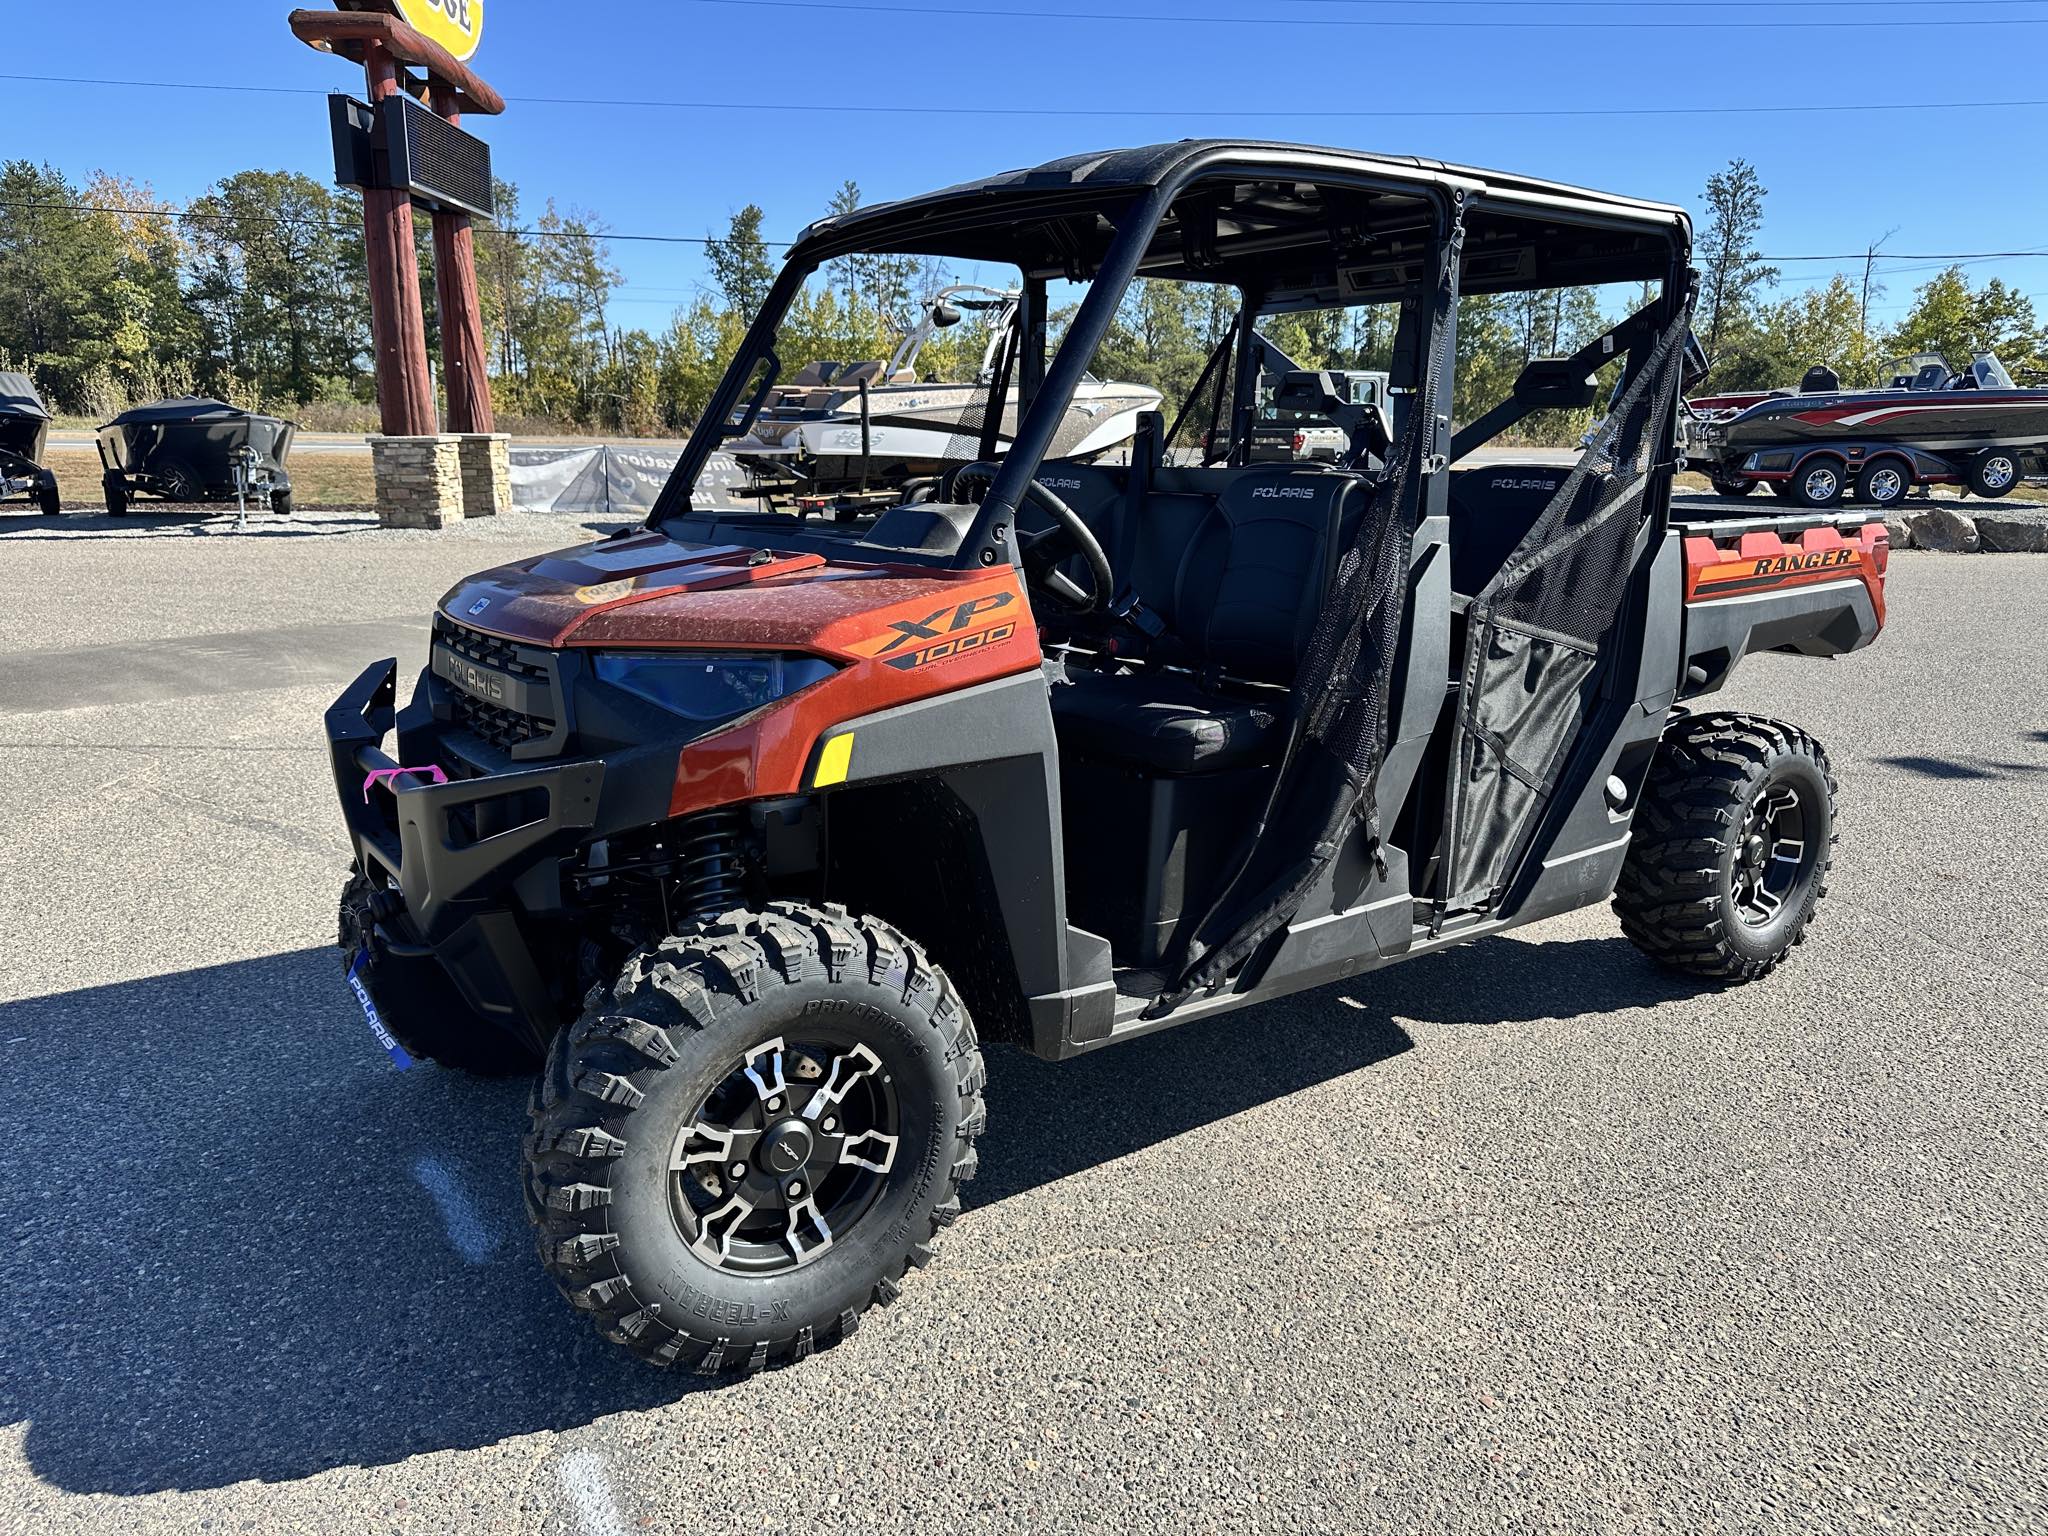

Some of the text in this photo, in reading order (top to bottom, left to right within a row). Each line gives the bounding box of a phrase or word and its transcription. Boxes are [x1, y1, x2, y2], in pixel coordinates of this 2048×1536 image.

[1039, 477, 1081, 489] POLARIS
[1252, 487, 1315, 499] POLARIS
[1491, 478, 1556, 491] POLARIS
[1753, 548, 1853, 575] RANGER
[874, 591, 1015, 655] XP
[914, 622, 1015, 666] 1000
[449, 656, 503, 699] POLARIS
[349, 976, 397, 1050] POLARIS
[802, 999, 850, 1016] PRO
[657, 1267, 790, 1327] X-TERRAIN
